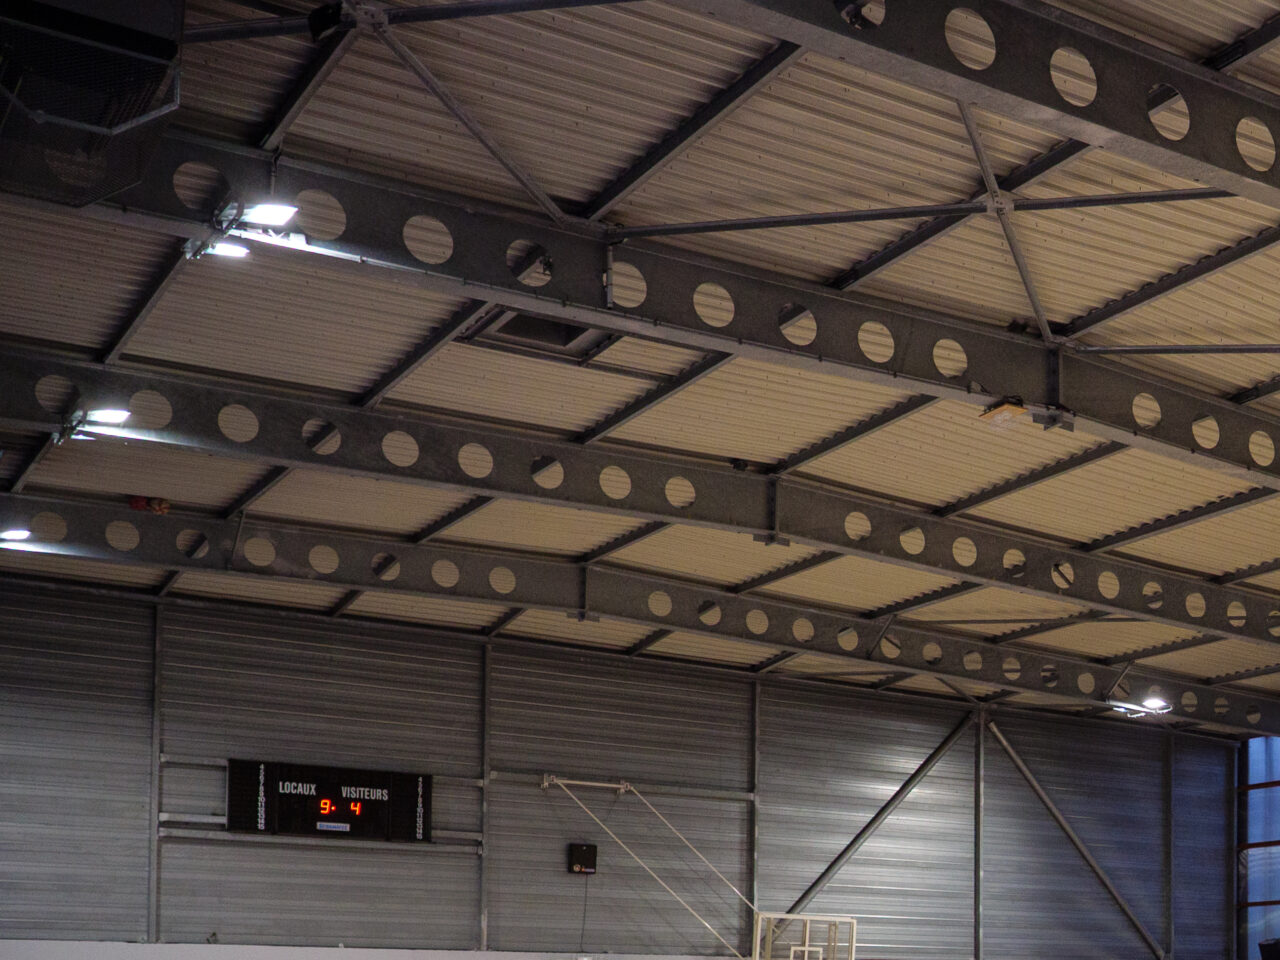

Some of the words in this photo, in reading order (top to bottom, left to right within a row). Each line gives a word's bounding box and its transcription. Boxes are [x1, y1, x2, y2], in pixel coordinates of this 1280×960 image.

[279, 781, 316, 796] LOCAUX
[341, 786, 389, 801] VISITEURS
[350, 802, 361, 815] 4
